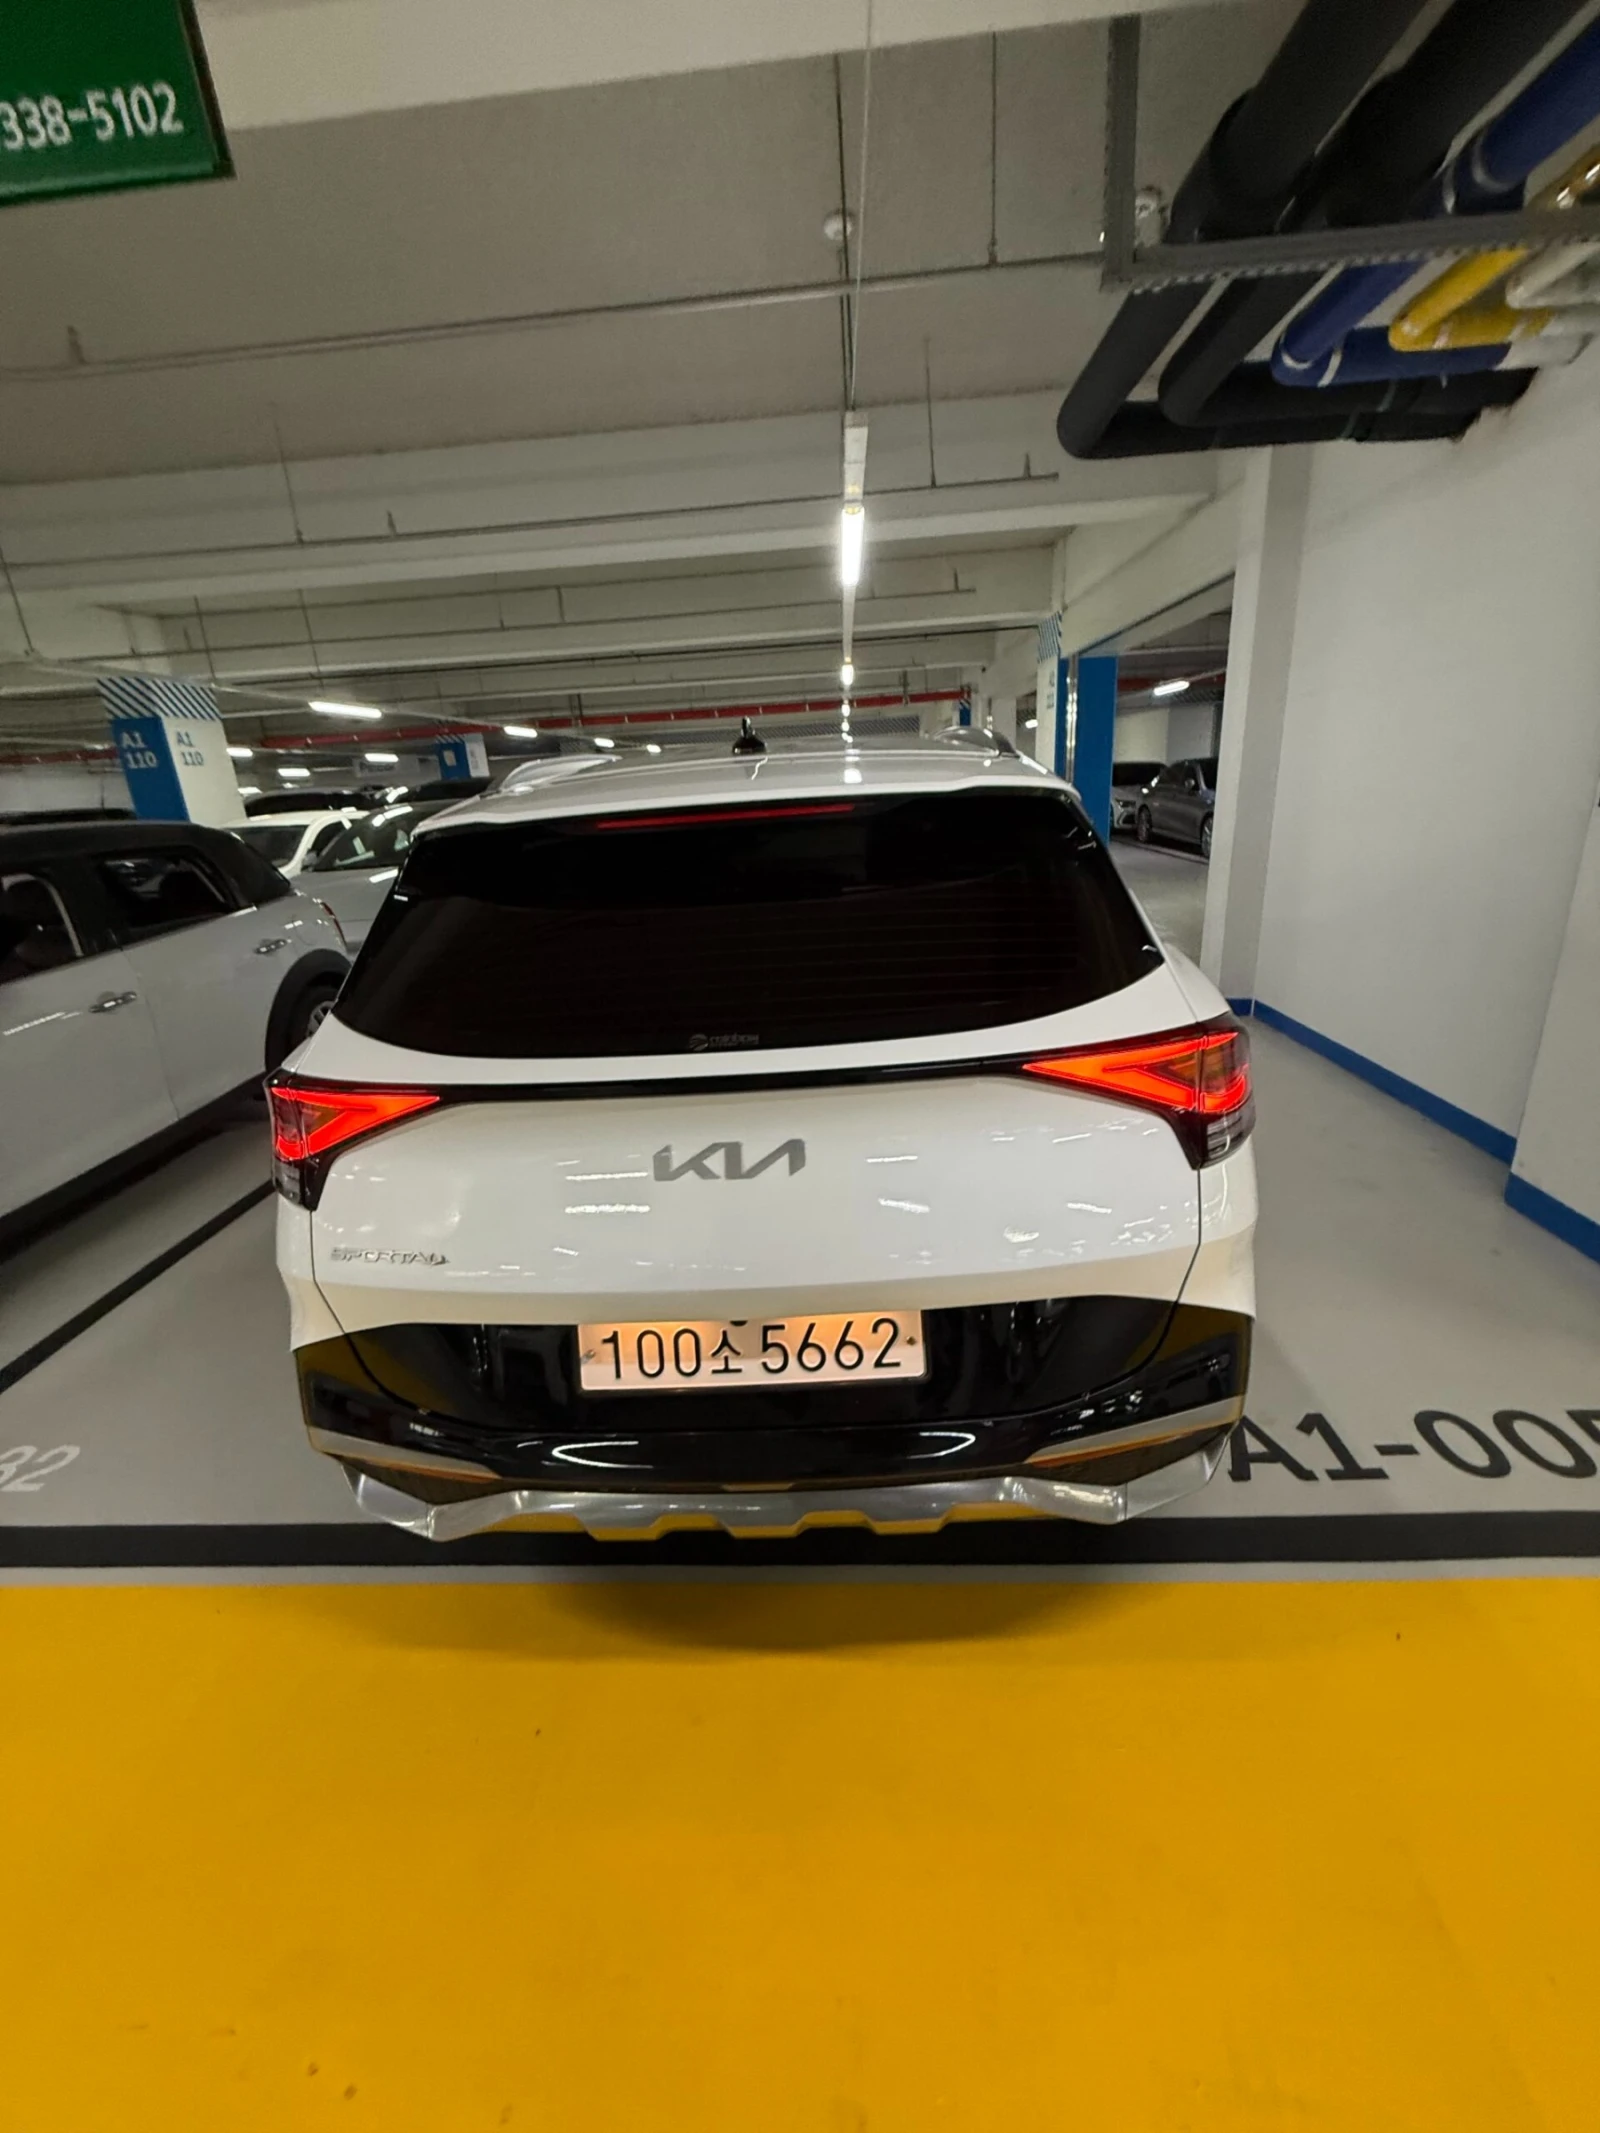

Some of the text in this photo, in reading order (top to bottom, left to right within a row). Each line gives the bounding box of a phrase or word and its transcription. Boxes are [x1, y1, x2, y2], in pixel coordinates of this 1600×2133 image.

[121, 731, 147, 749] A1
[175, 730, 195, 748] A1
[124, 751, 158, 769] 110
[181, 751, 204, 767] 110
[653, 1138, 806, 1182] KIA
[331, 1247, 451, 1267] SPORTA
[1227, 1409, 1600, 1483] A1-00
